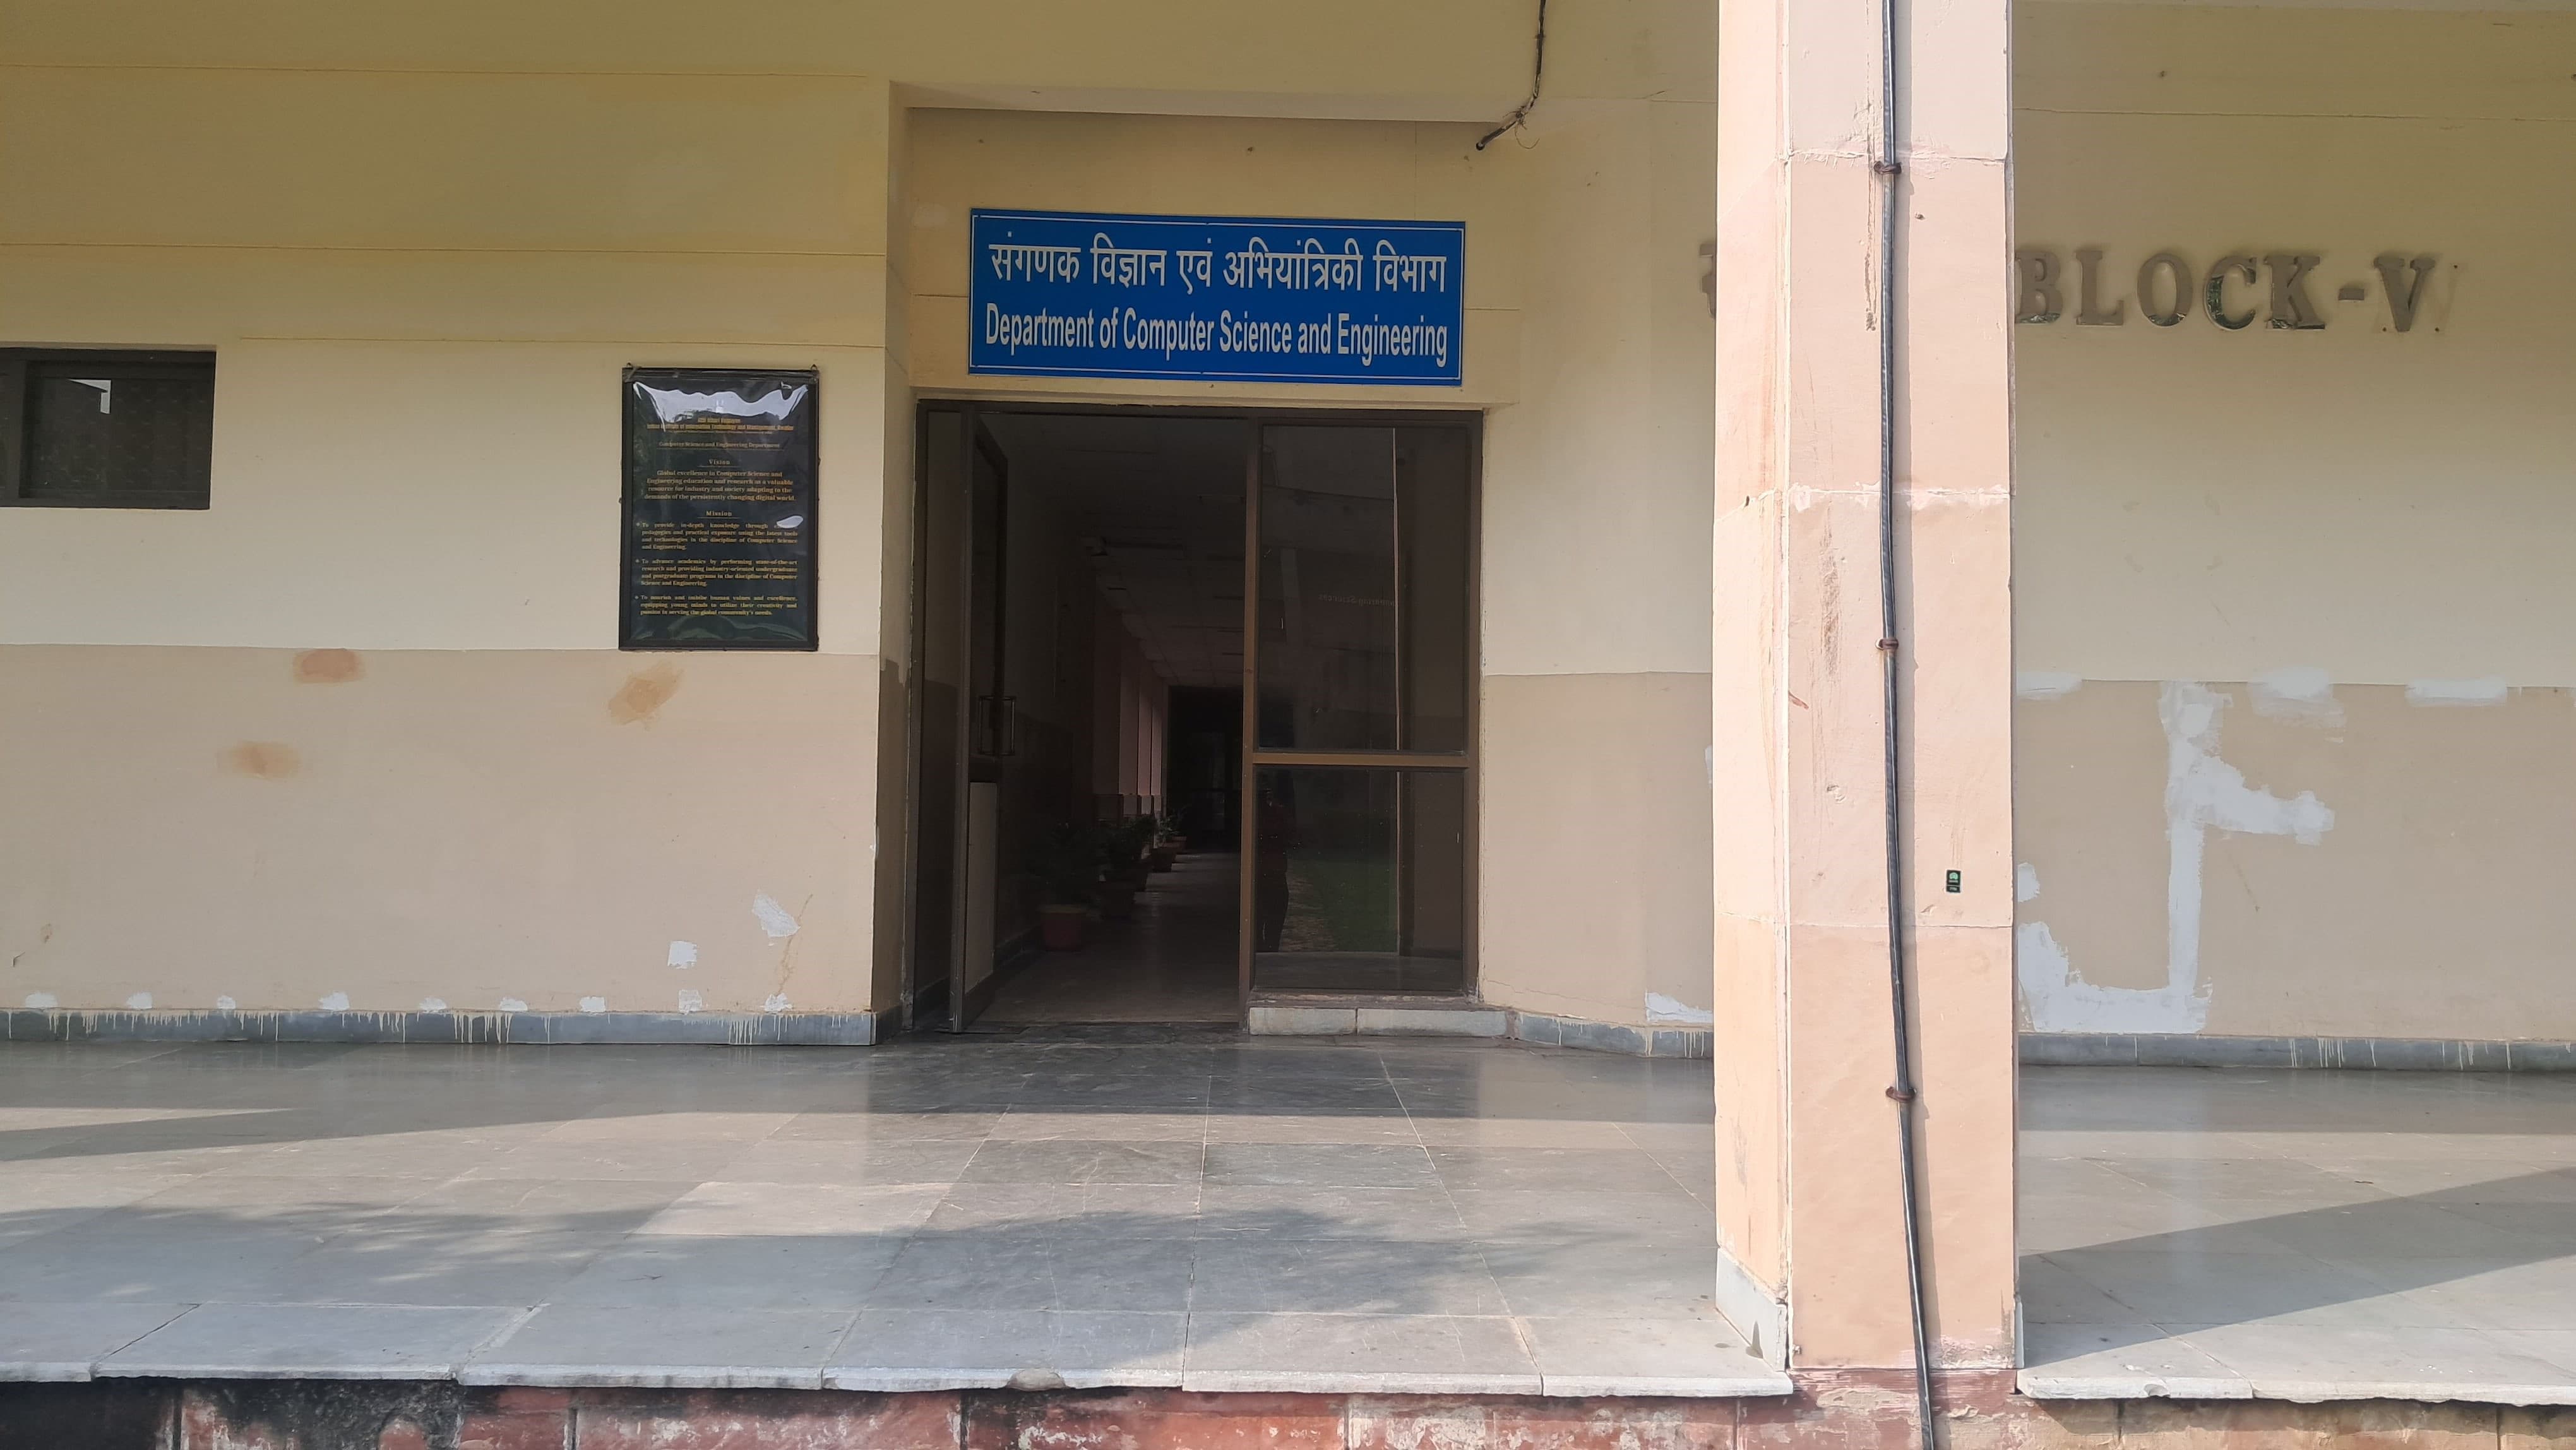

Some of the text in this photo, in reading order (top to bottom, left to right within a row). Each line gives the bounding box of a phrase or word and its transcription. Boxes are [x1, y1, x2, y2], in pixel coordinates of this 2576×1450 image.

[989, 231, 1448, 294] संगणक विज्ञान एवं अभियांत्रिकी विभाग
[986, 303, 1448, 368] Department of Computer Science and Engineering
